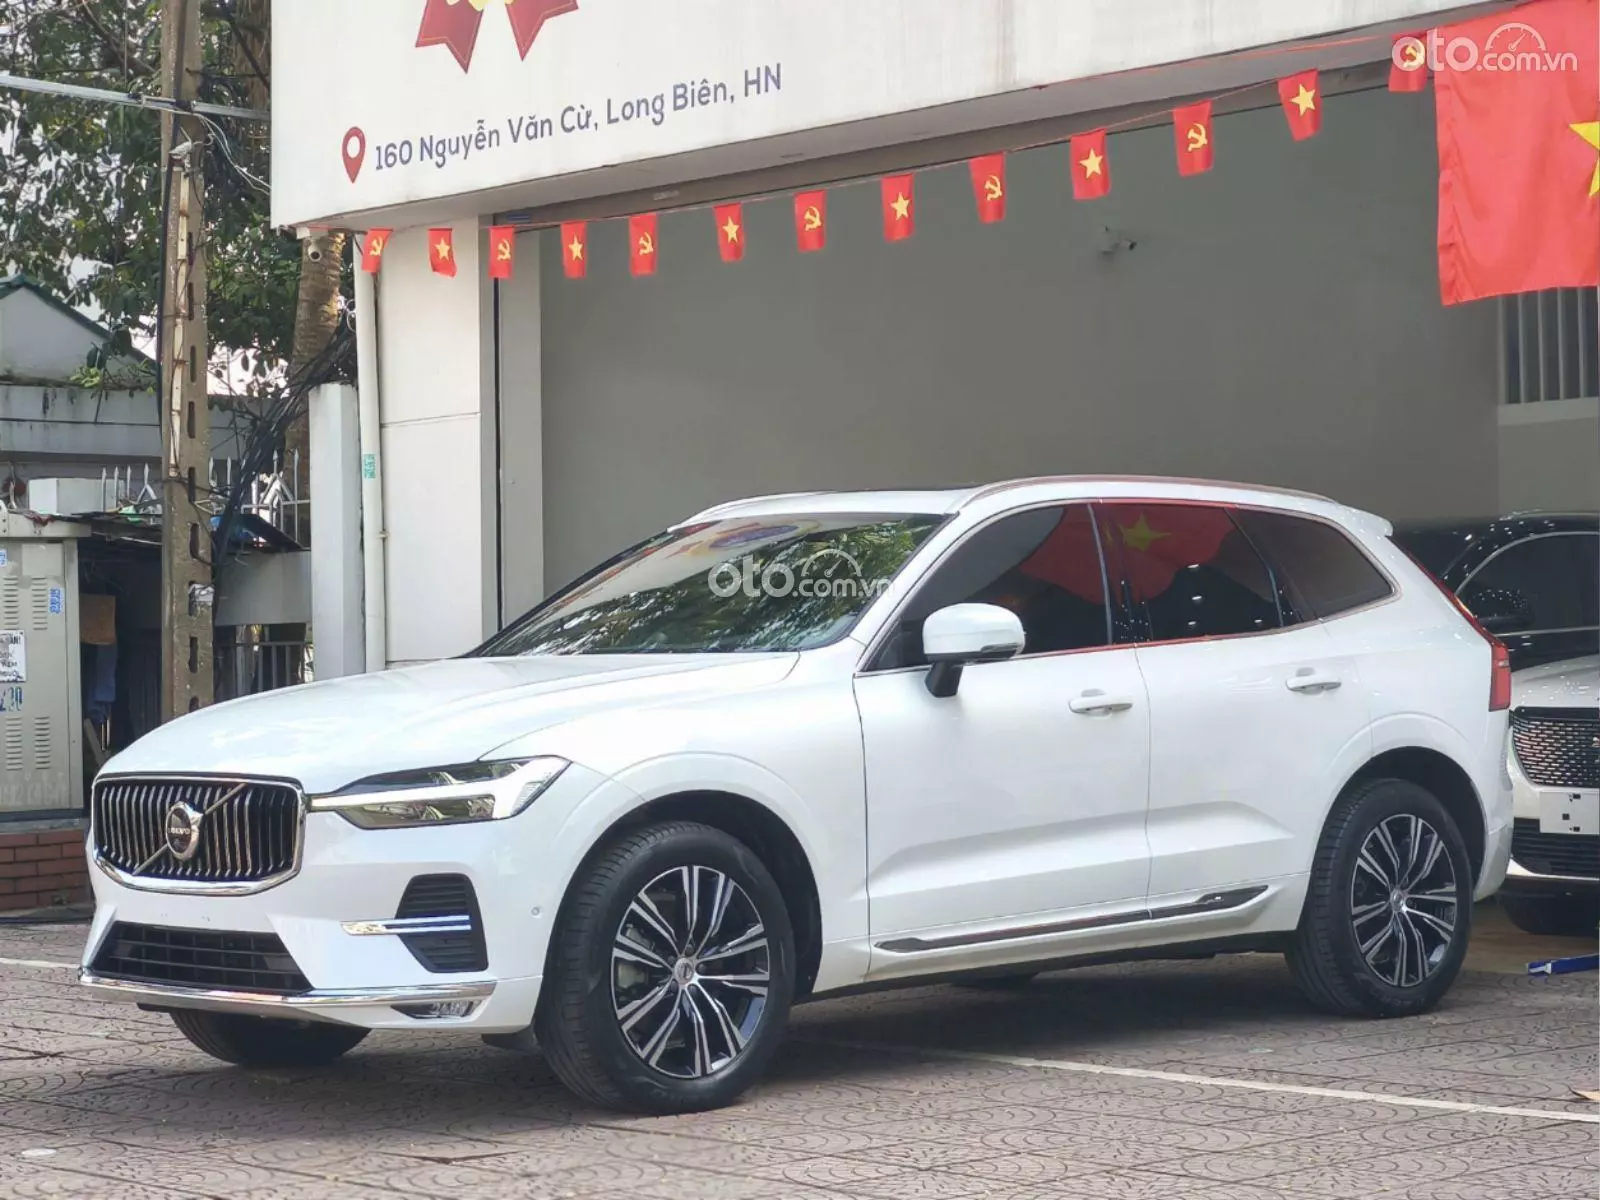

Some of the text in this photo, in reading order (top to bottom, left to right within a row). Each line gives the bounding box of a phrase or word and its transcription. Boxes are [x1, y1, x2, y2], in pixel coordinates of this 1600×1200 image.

[375, 62, 781, 171] 160 Nguyễn Văn Cừ, Long Biên, HN
